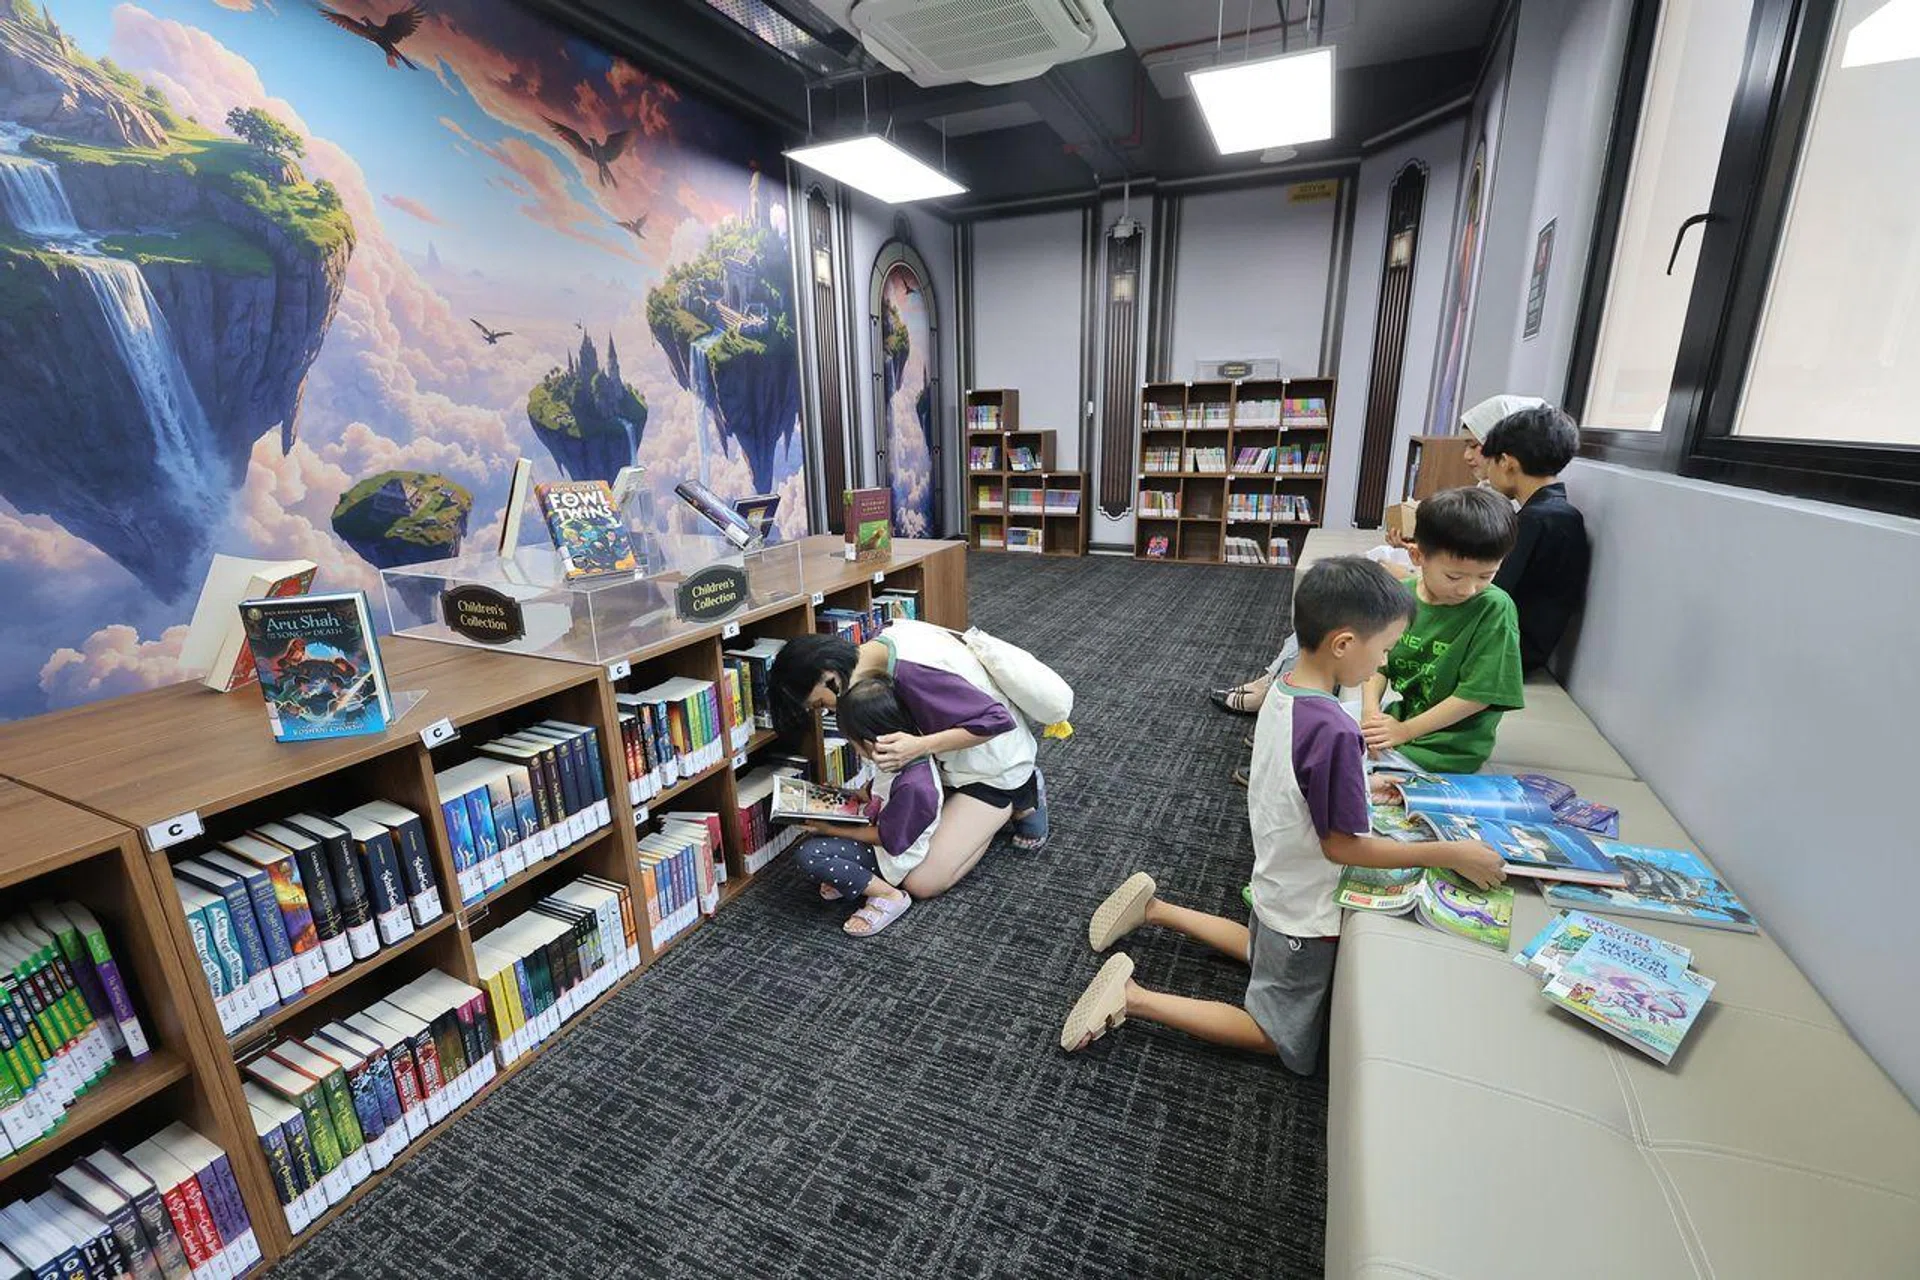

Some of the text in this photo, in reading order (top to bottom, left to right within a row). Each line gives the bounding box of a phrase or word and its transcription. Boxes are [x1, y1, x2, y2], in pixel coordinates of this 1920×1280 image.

[548, 490, 610, 509] FOWL
[554, 505, 613, 521] TWINS
[691, 578, 735, 598] Children's
[457, 599, 505, 616] Children's
[693, 591, 736, 611] Collection
[266, 612, 341, 632] Aru Shah
[460, 613, 507, 630] Collection
[616, 666, 623, 675] C
[433, 728, 443, 738] C
[635, 812, 642, 822] D
[168, 822, 184, 837] C
[1598, 937, 1668, 971] DRAGON
[1600, 945, 1668, 979] MASTERS
